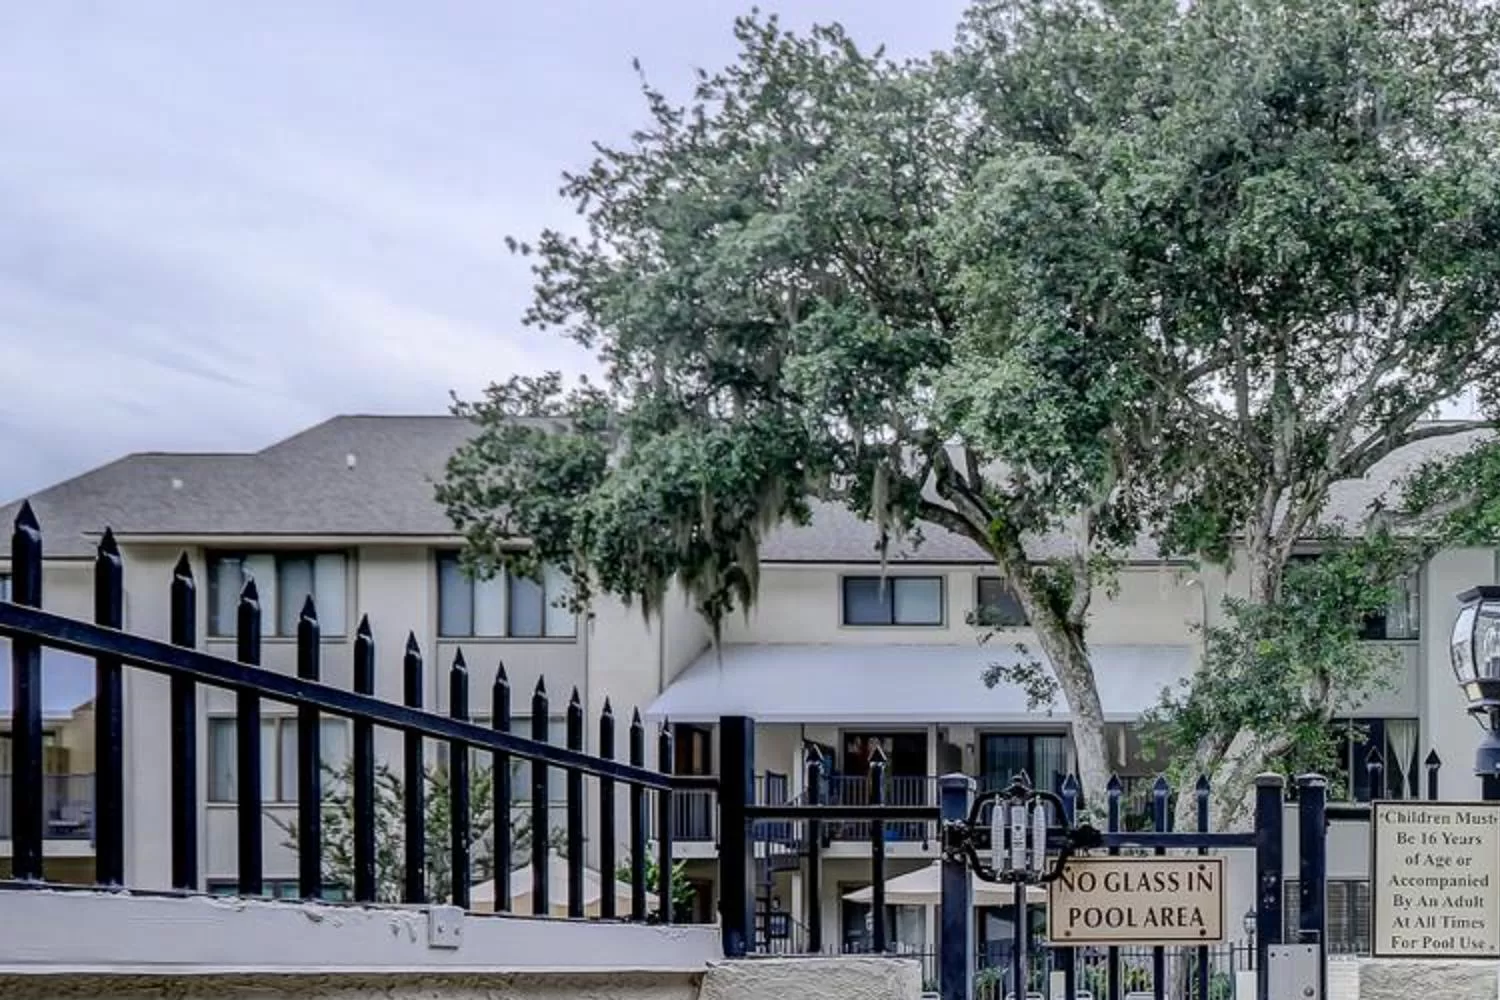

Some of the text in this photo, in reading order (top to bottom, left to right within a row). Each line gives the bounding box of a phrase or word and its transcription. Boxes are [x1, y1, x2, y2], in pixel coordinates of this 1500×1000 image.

[1385, 810, 1494, 825] Children Must
[1396, 831, 1482, 845] Be 16 Years
[1405, 852, 1473, 868] of Age or
[1059, 871, 1213, 893] NO GLASS IN
[1389, 874, 1489, 890] Accompanied
[1392, 893, 1484, 911] By An Adult
[1069, 906, 1205, 928] POOL AREA
[1391, 915, 1485, 929] At All Times
[1391, 935, 1487, 949] For Pool Use
